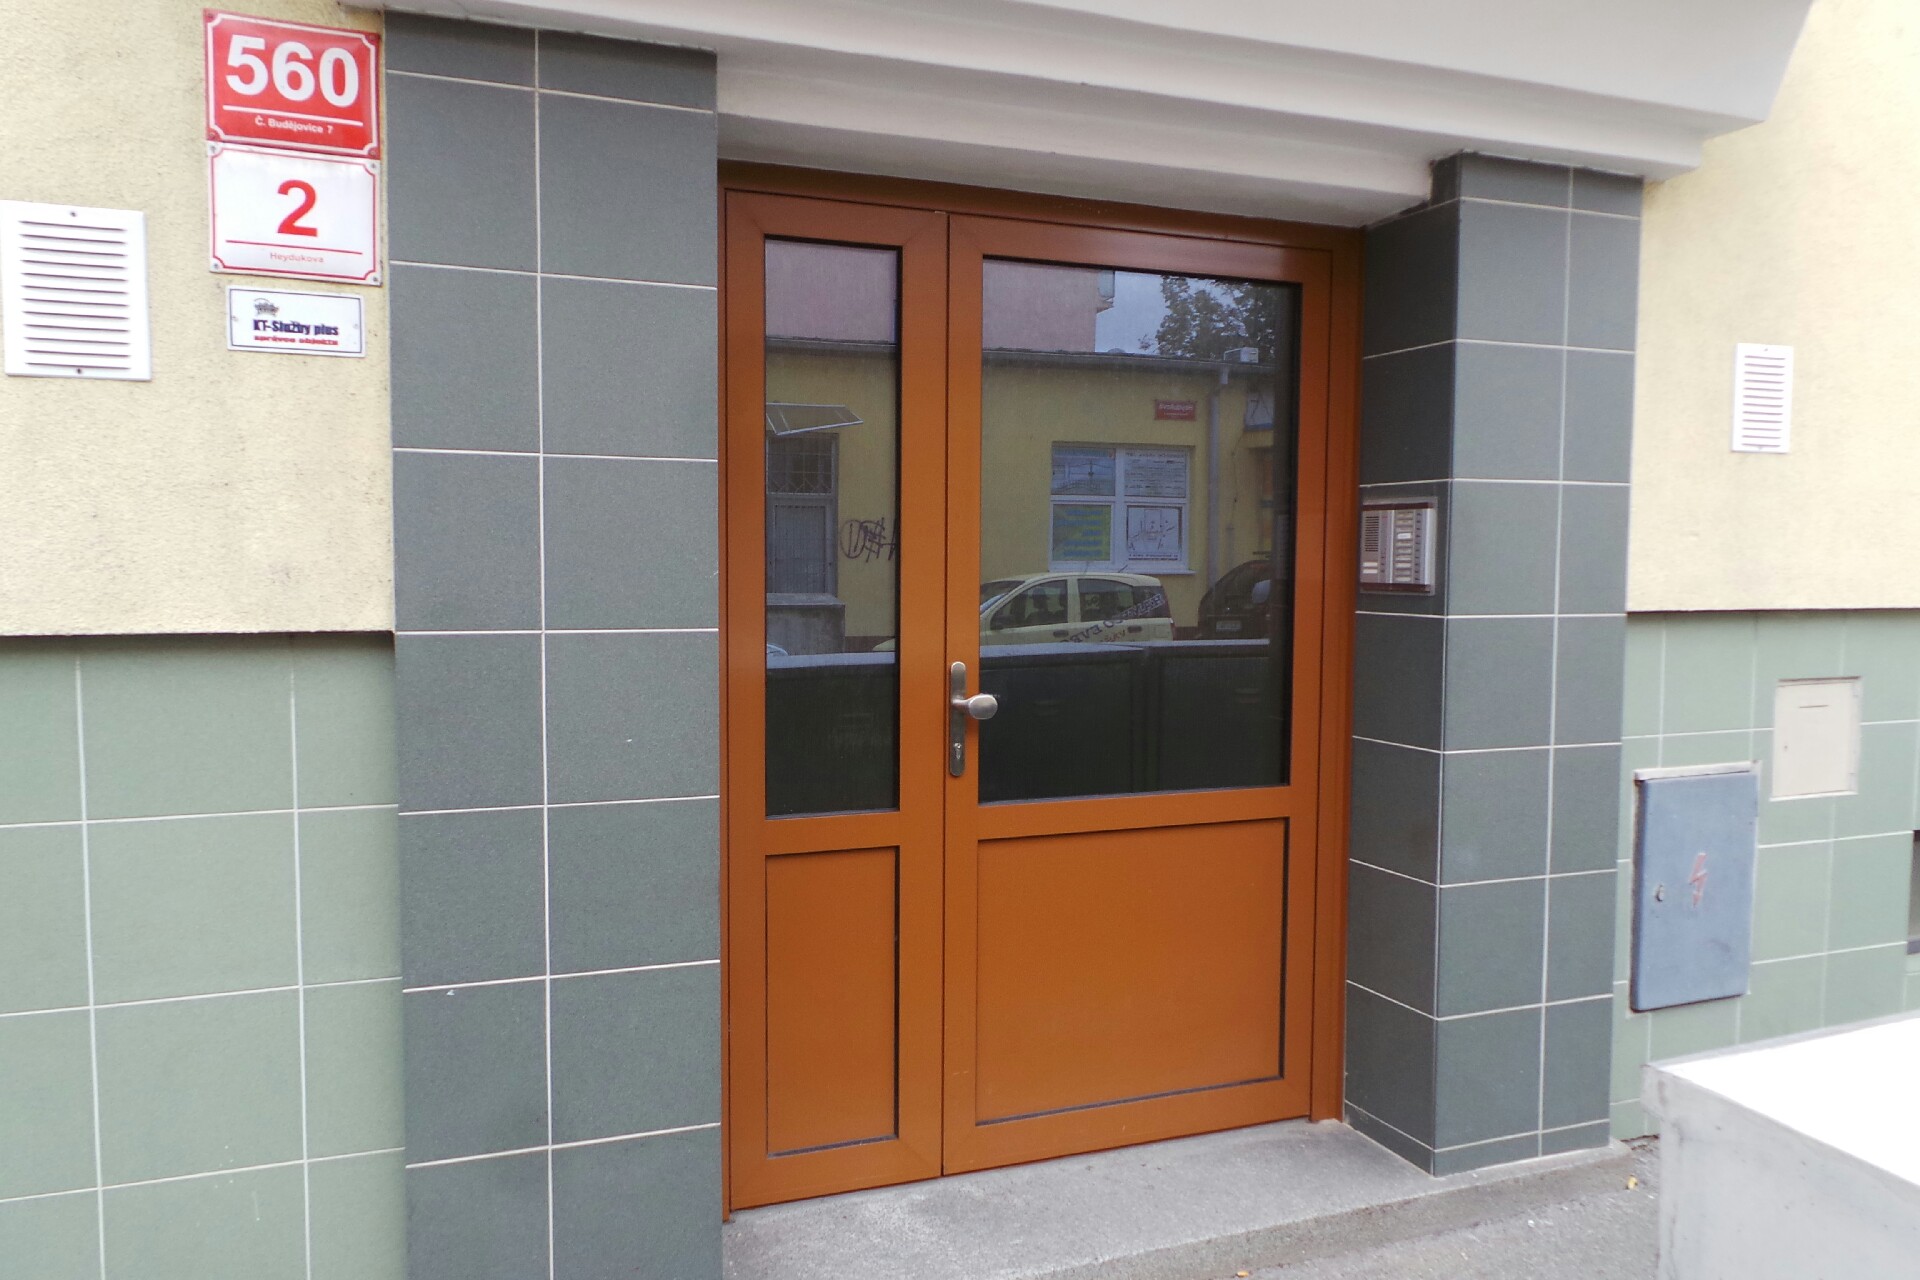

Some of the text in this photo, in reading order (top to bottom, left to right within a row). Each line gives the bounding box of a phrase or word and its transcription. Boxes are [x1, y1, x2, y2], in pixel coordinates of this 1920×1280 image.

[225, 34, 359, 107] 560
[254, 115, 334, 134] Č. Budějovice 7
[277, 179, 318, 237] 2
[269, 251, 325, 264] Heydukova
[253, 319, 339, 336] KT-Služby plus
